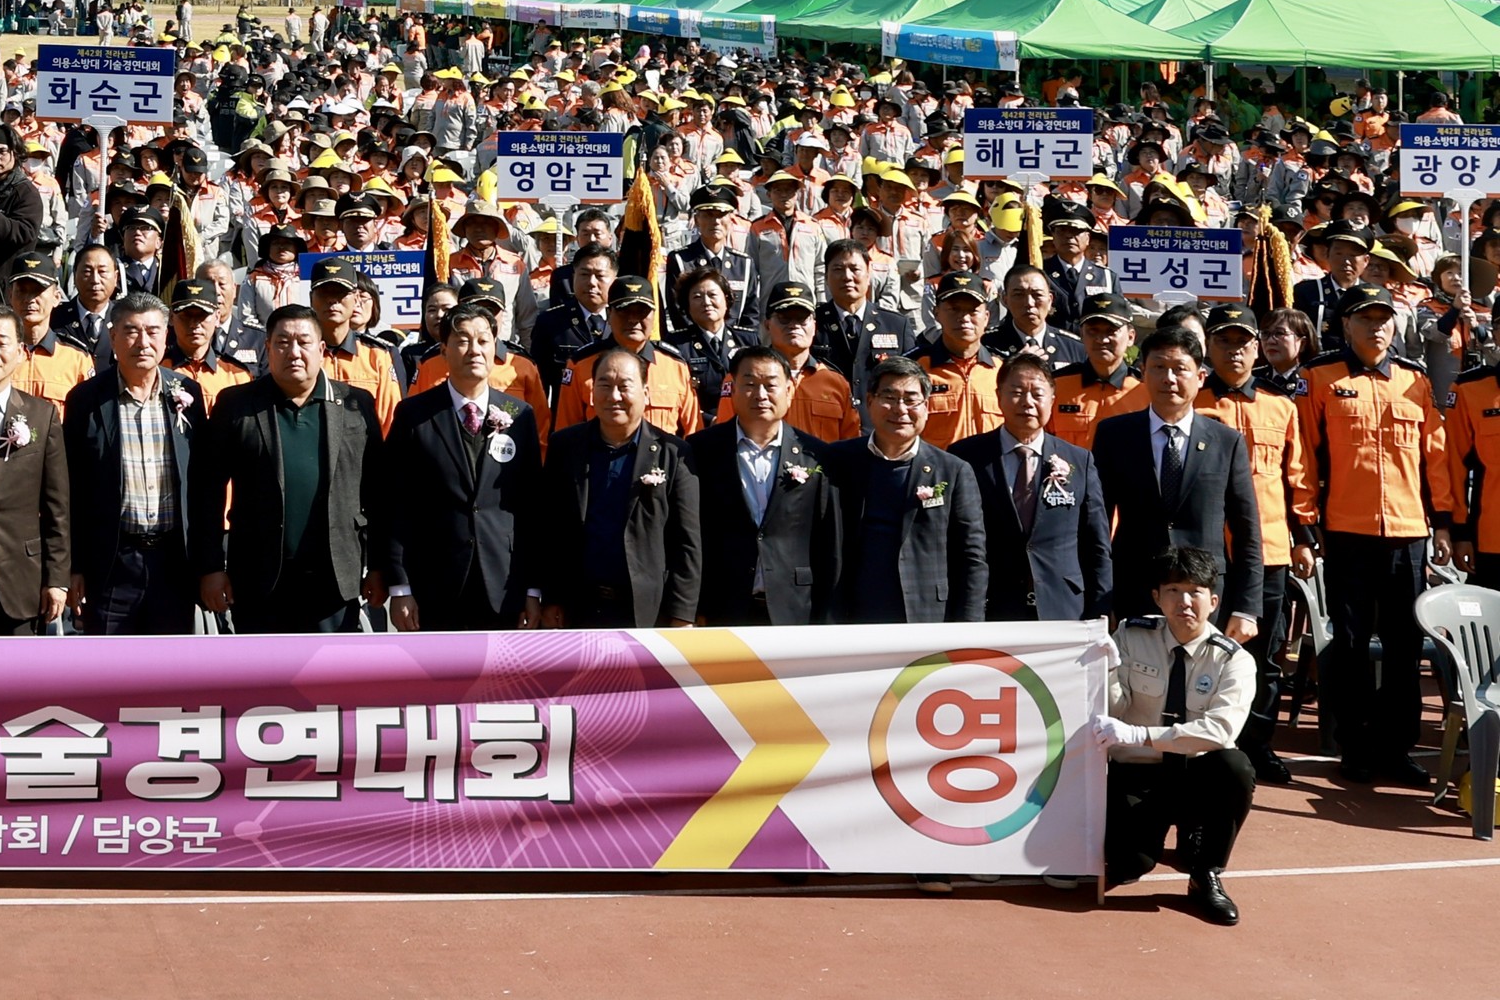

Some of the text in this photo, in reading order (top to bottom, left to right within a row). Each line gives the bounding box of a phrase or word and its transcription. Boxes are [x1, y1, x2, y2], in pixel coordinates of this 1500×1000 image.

[77, 48, 136, 58] 제42회 전라남도
[52, 58, 160, 72] 의용소방대 기술경연대회
[48, 77, 162, 113] 화순군
[1001, 111, 1057, 119] 제42회 전라남도
[977, 120, 1080, 130] 의용소방대 기술경연대회
[1437, 127, 1492, 136] 제42회 전라남도
[533, 135, 588, 143] 제42회 전라남도
[1413, 136, 1500, 147] 의용소방대 기술경연
[510, 143, 610, 154] 의용소방대 기술경연대회
[975, 139, 1082, 169] 해남군
[509, 162, 612, 192] 영암군
[1147, 229, 1204, 238] 제42회 전라남도
[1122, 237, 1229, 250] 의용소방대 기술경연대회
[365, 254, 396, 262] 전라남도
[364, 263, 420, 275] 기술경연대회
[1119, 258, 1231, 289] 보성군
[916, 686, 1018, 804] 영
[93, 815, 222, 854] 담양군
